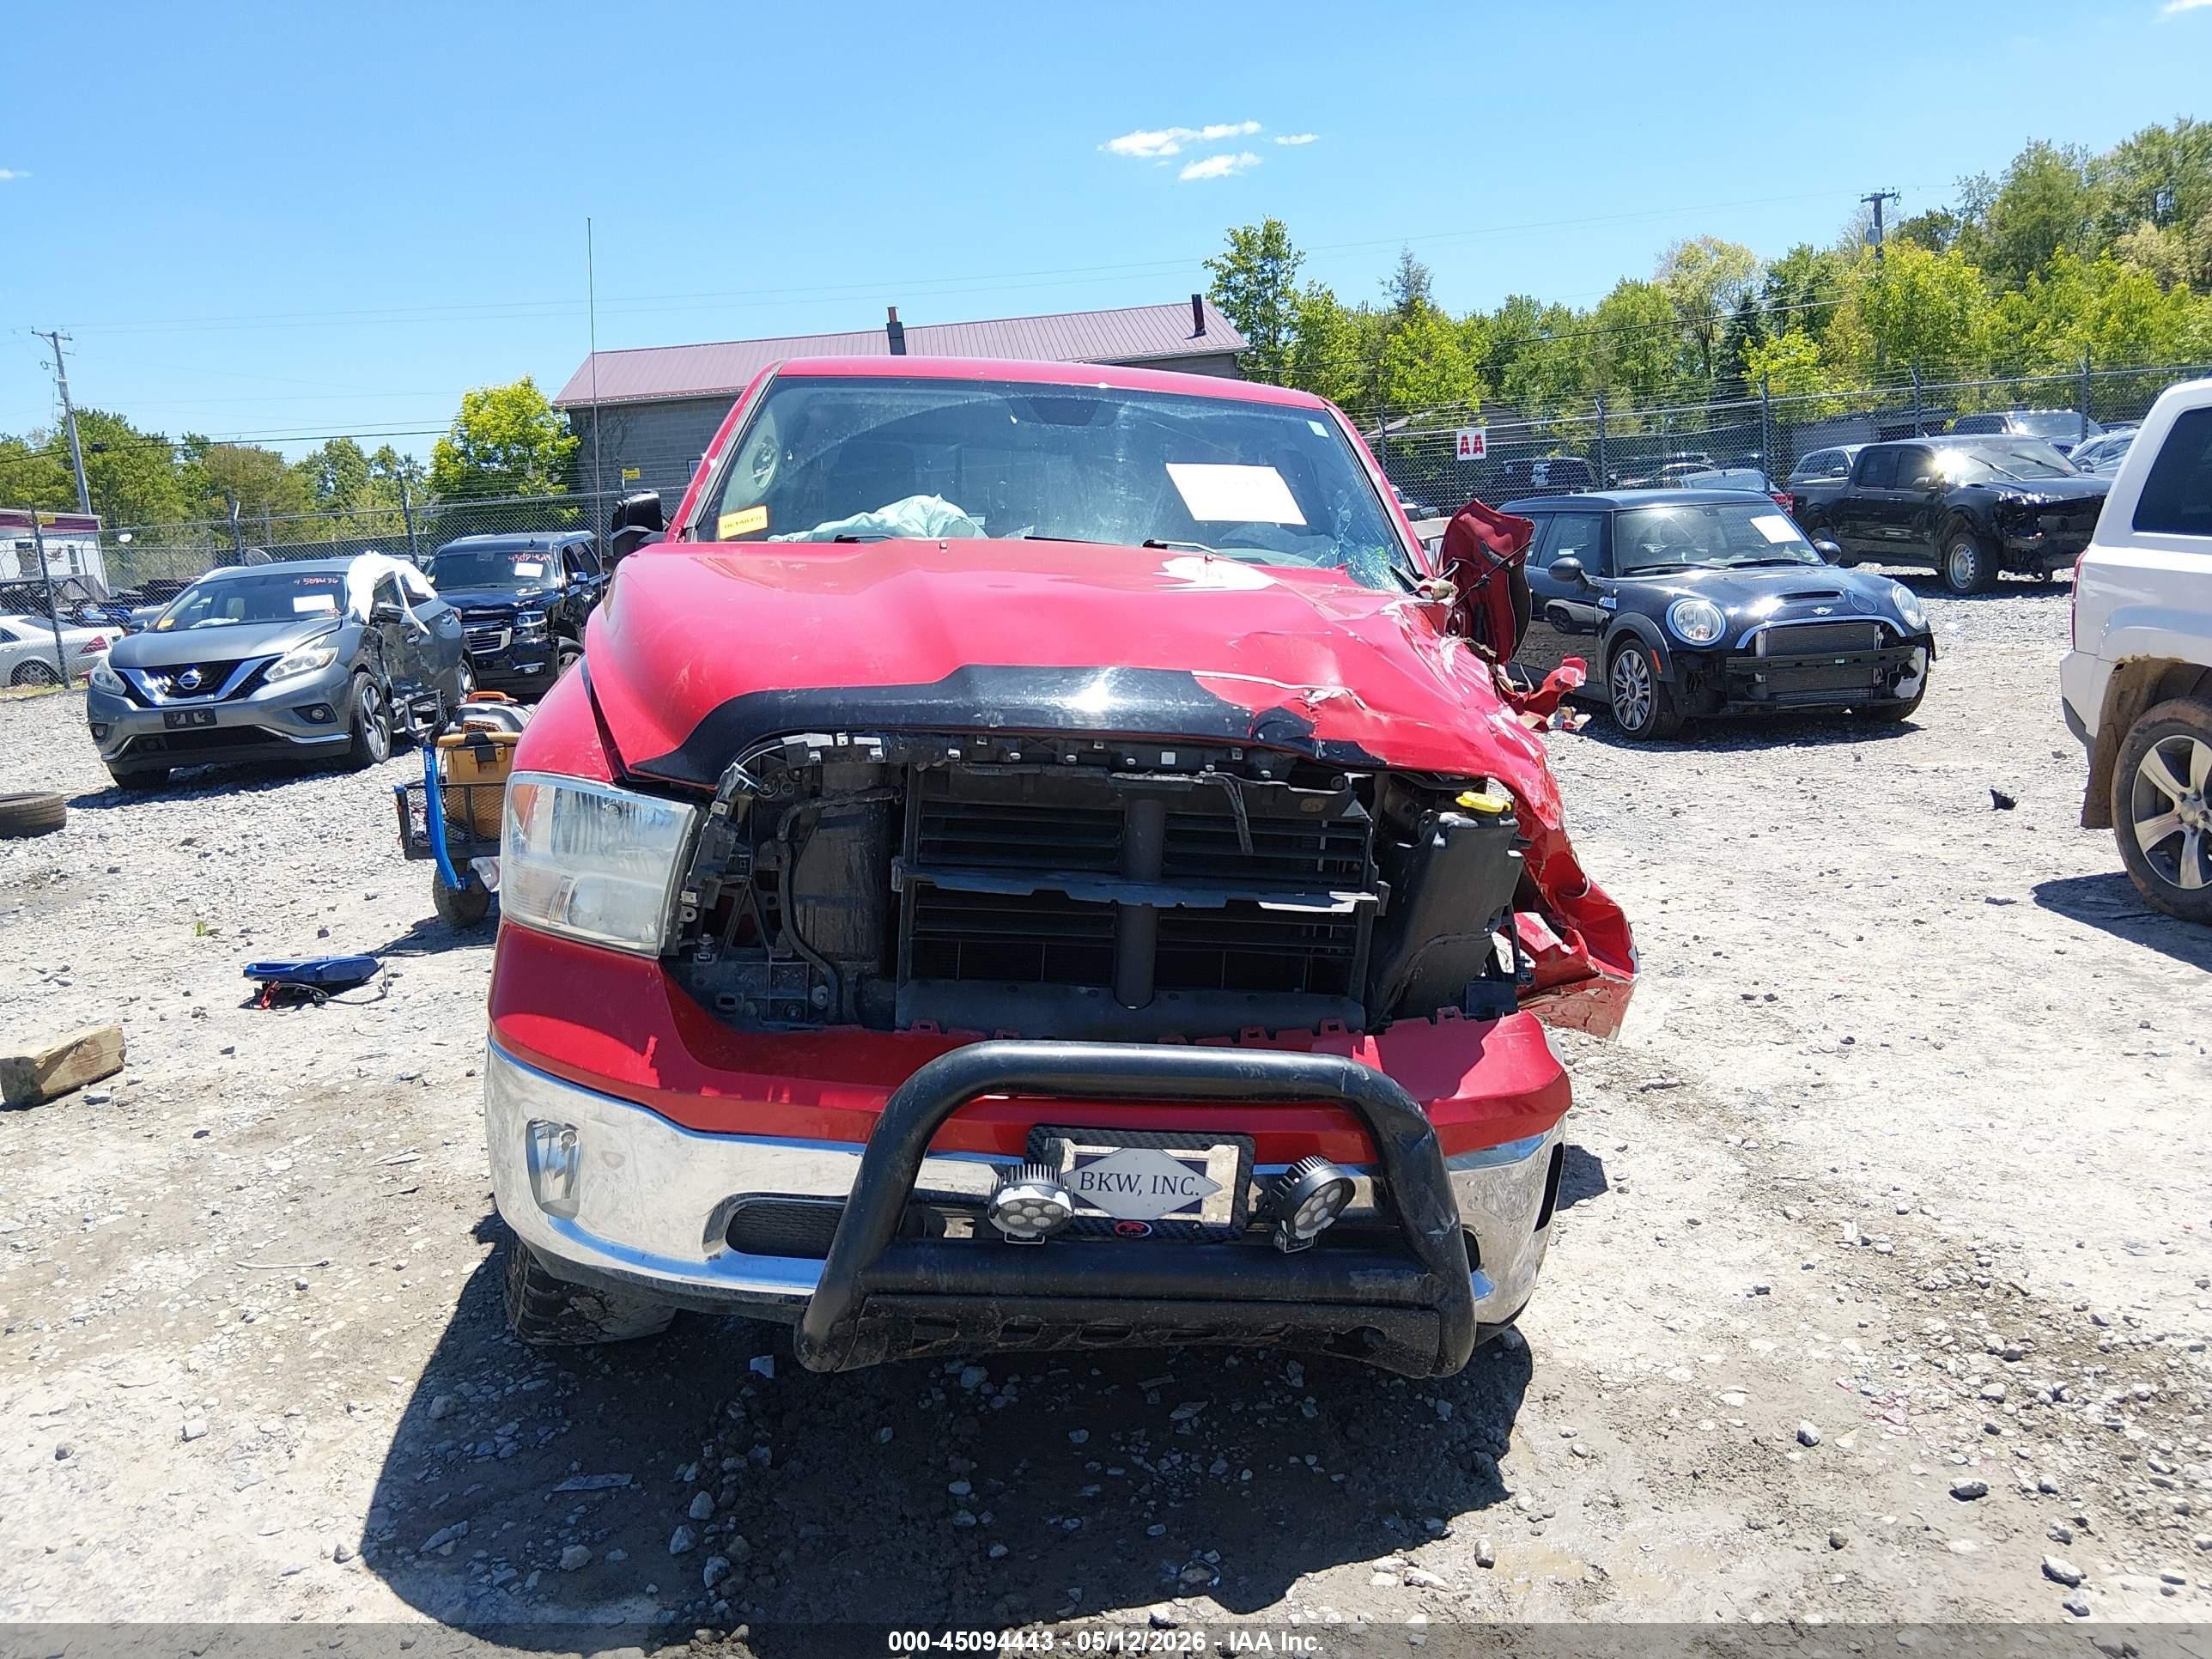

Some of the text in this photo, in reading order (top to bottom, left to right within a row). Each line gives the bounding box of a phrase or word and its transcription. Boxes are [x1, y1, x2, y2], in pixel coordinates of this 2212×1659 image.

[1459, 434, 1485, 455] AA
[1079, 1171, 1200, 1197] BKW, INC.
